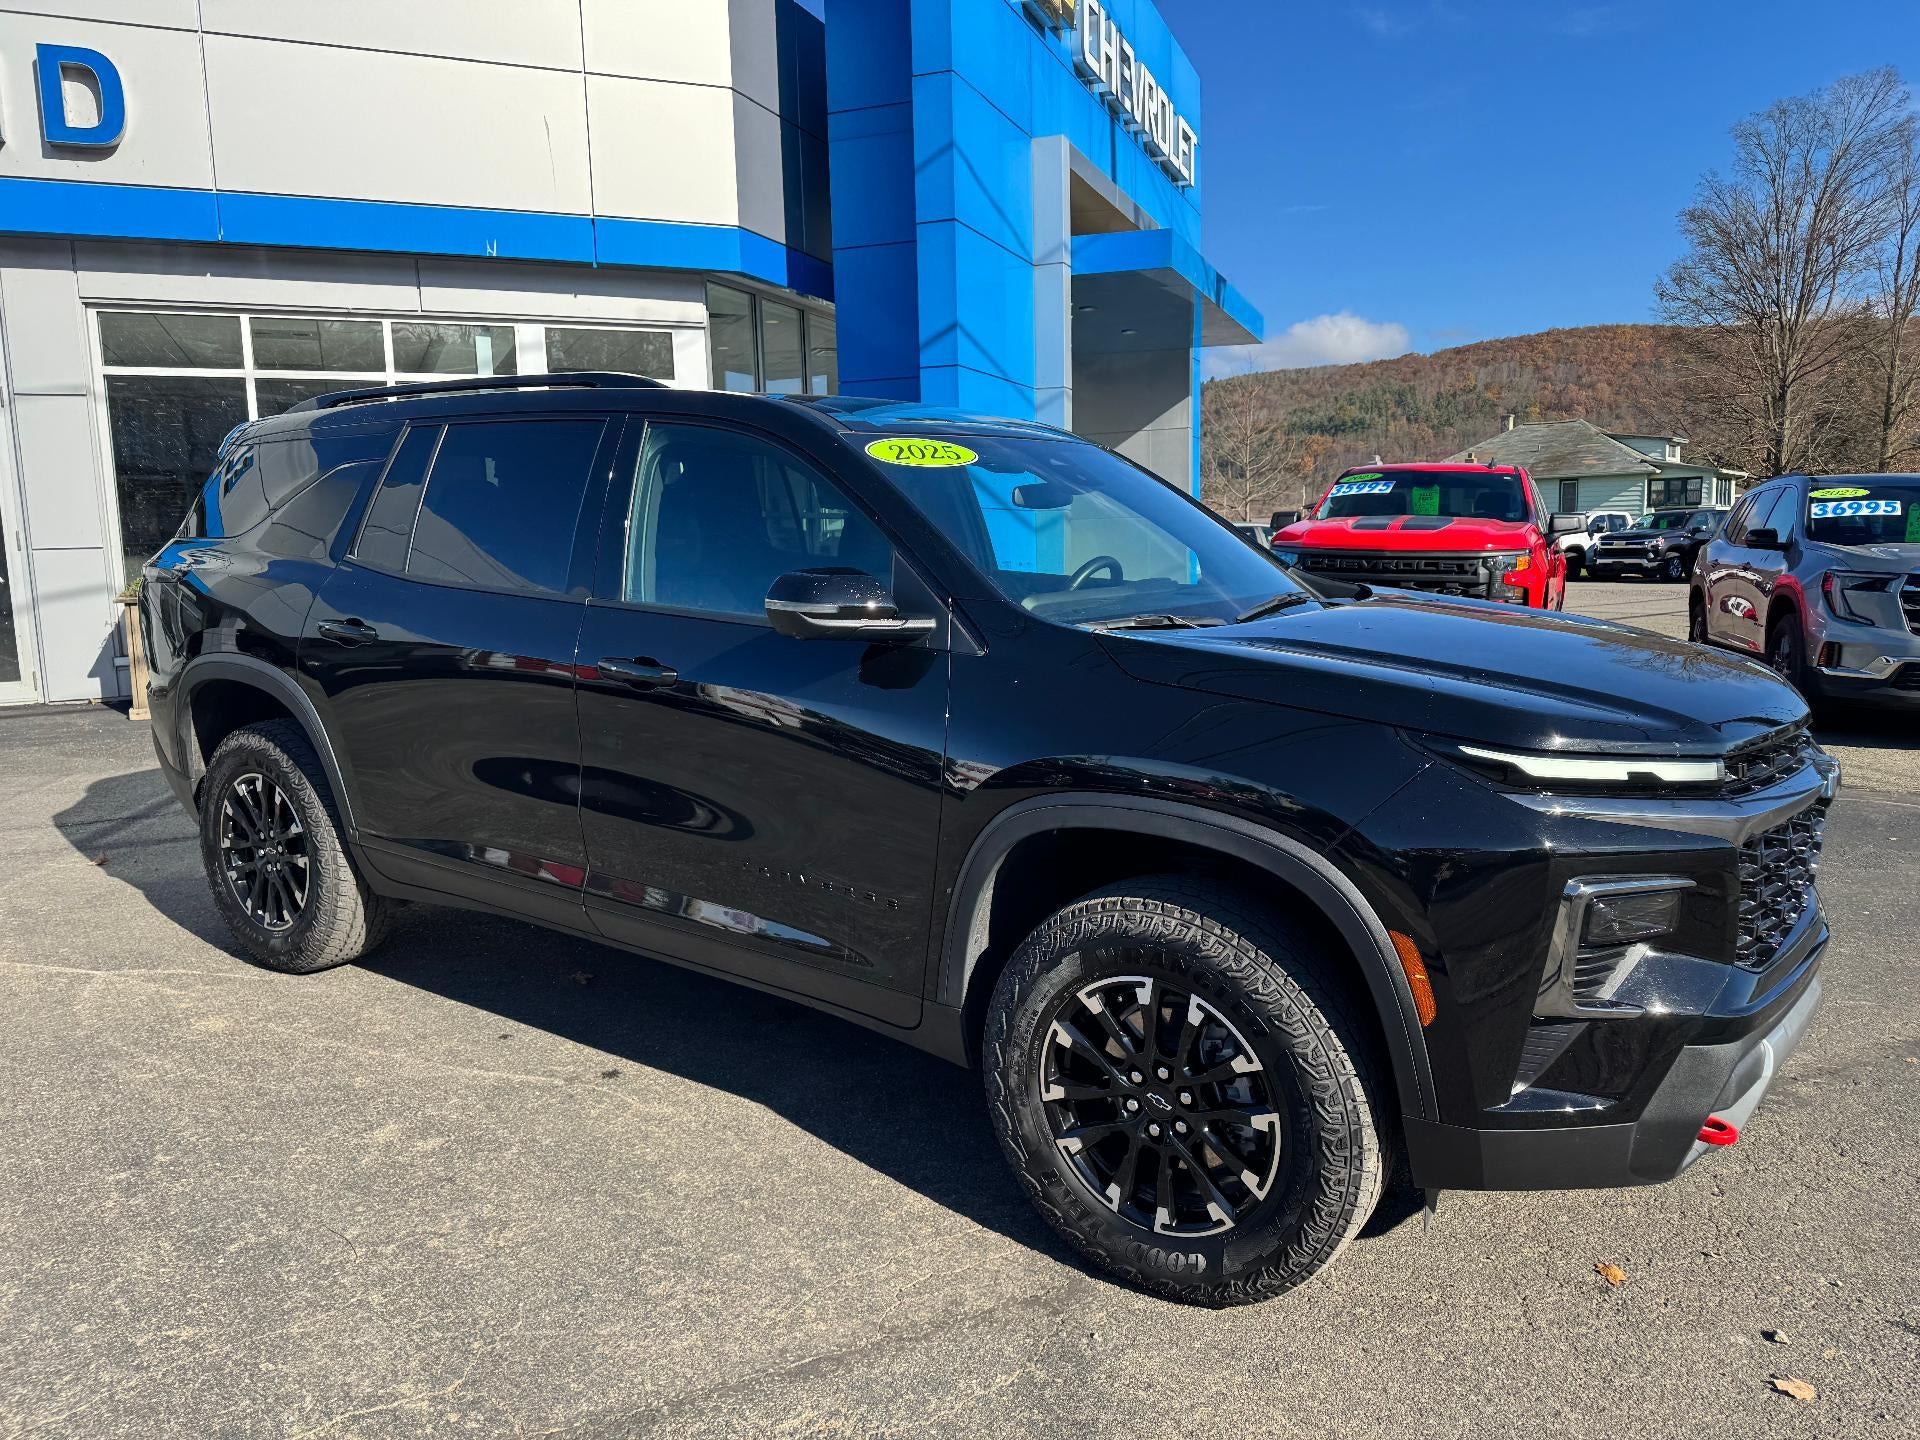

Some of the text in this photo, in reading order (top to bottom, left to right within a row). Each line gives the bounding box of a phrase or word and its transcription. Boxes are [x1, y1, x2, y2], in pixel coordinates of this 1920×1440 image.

[1081, 0, 1197, 188] CHEVROLET
[888, 444, 962, 461] 2025
[1330, 481, 1394, 497] 35995
[1813, 501, 1899, 517] 36995
[1307, 558, 1479, 576] CHEVROLET
